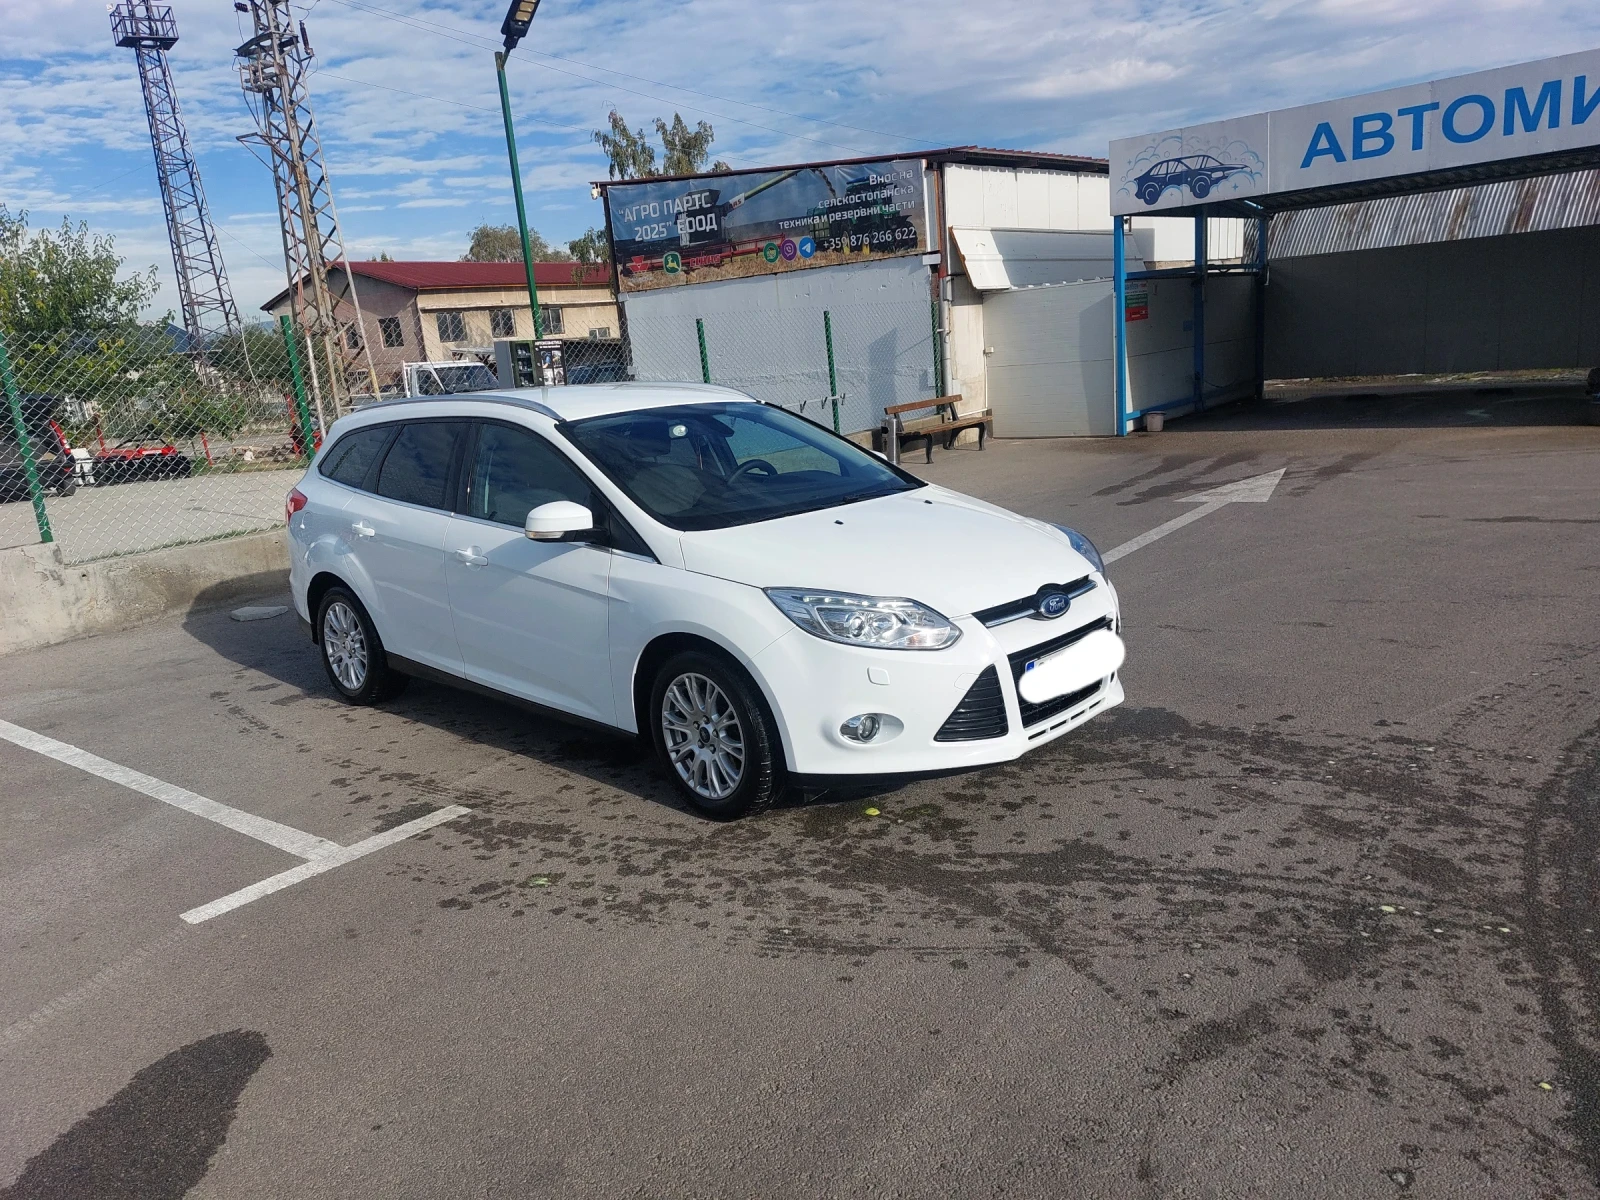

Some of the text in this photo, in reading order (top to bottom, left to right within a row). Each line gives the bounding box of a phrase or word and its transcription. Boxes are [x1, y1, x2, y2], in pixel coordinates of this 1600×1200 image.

[869, 169, 913, 185] Внос на
[663, 192, 711, 214] ПАРТС
[818, 184, 914, 209] селскостопанска
[677, 213, 718, 234] ЕООД
[778, 200, 915, 230] техника и резервни части
[823, 226, 916, 250] +359 876 266 622
